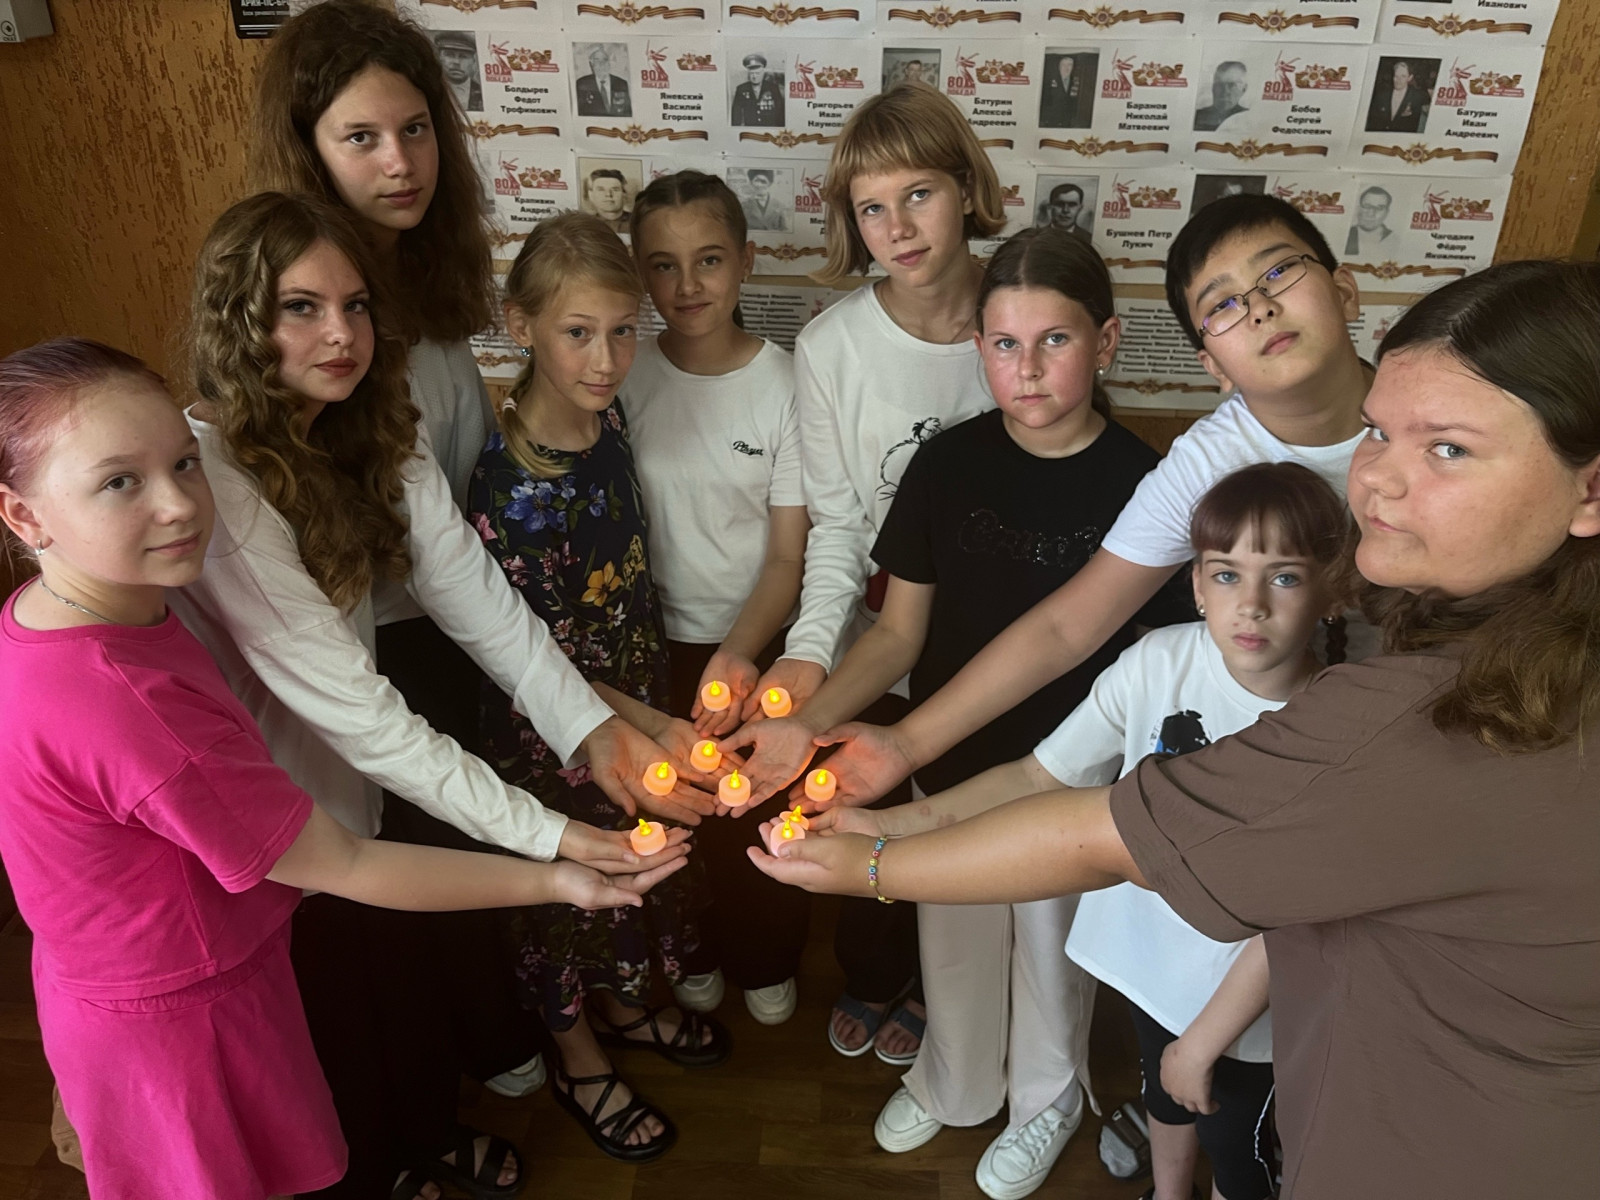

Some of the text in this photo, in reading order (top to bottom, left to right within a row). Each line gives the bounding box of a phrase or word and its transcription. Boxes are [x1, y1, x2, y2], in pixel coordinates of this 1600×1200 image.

[1478, 0, 1527, 8] Иванович
[504, 86, 548, 94] Болдырев
[514, 96, 541, 104] Федот
[660, 92, 703, 100] Яневский
[974, 97, 1012, 106] Батурин
[500, 106, 557, 114] Трофимович
[1126, 102, 1167, 110] Баранов
[1291, 105, 1320, 113] Бобов
[1126, 112, 1168, 120] Николай
[1457, 108, 1497, 117] Батурин
[662, 113, 703, 121] Егорович
[1286, 116, 1321, 125] Сергей
[1118, 123, 1169, 131] Матвеевич
[1462, 119, 1487, 127] Иван
[1272, 126, 1332, 135] Федосеевич
[1445, 129, 1498, 138] Андреевич
[1106, 229, 1172, 239] Бушнев Петр
[1431, 232, 1474, 240] Чагодаев
[1122, 240, 1153, 249] Лукич
[1425, 252, 1476, 260] Яковлевич
